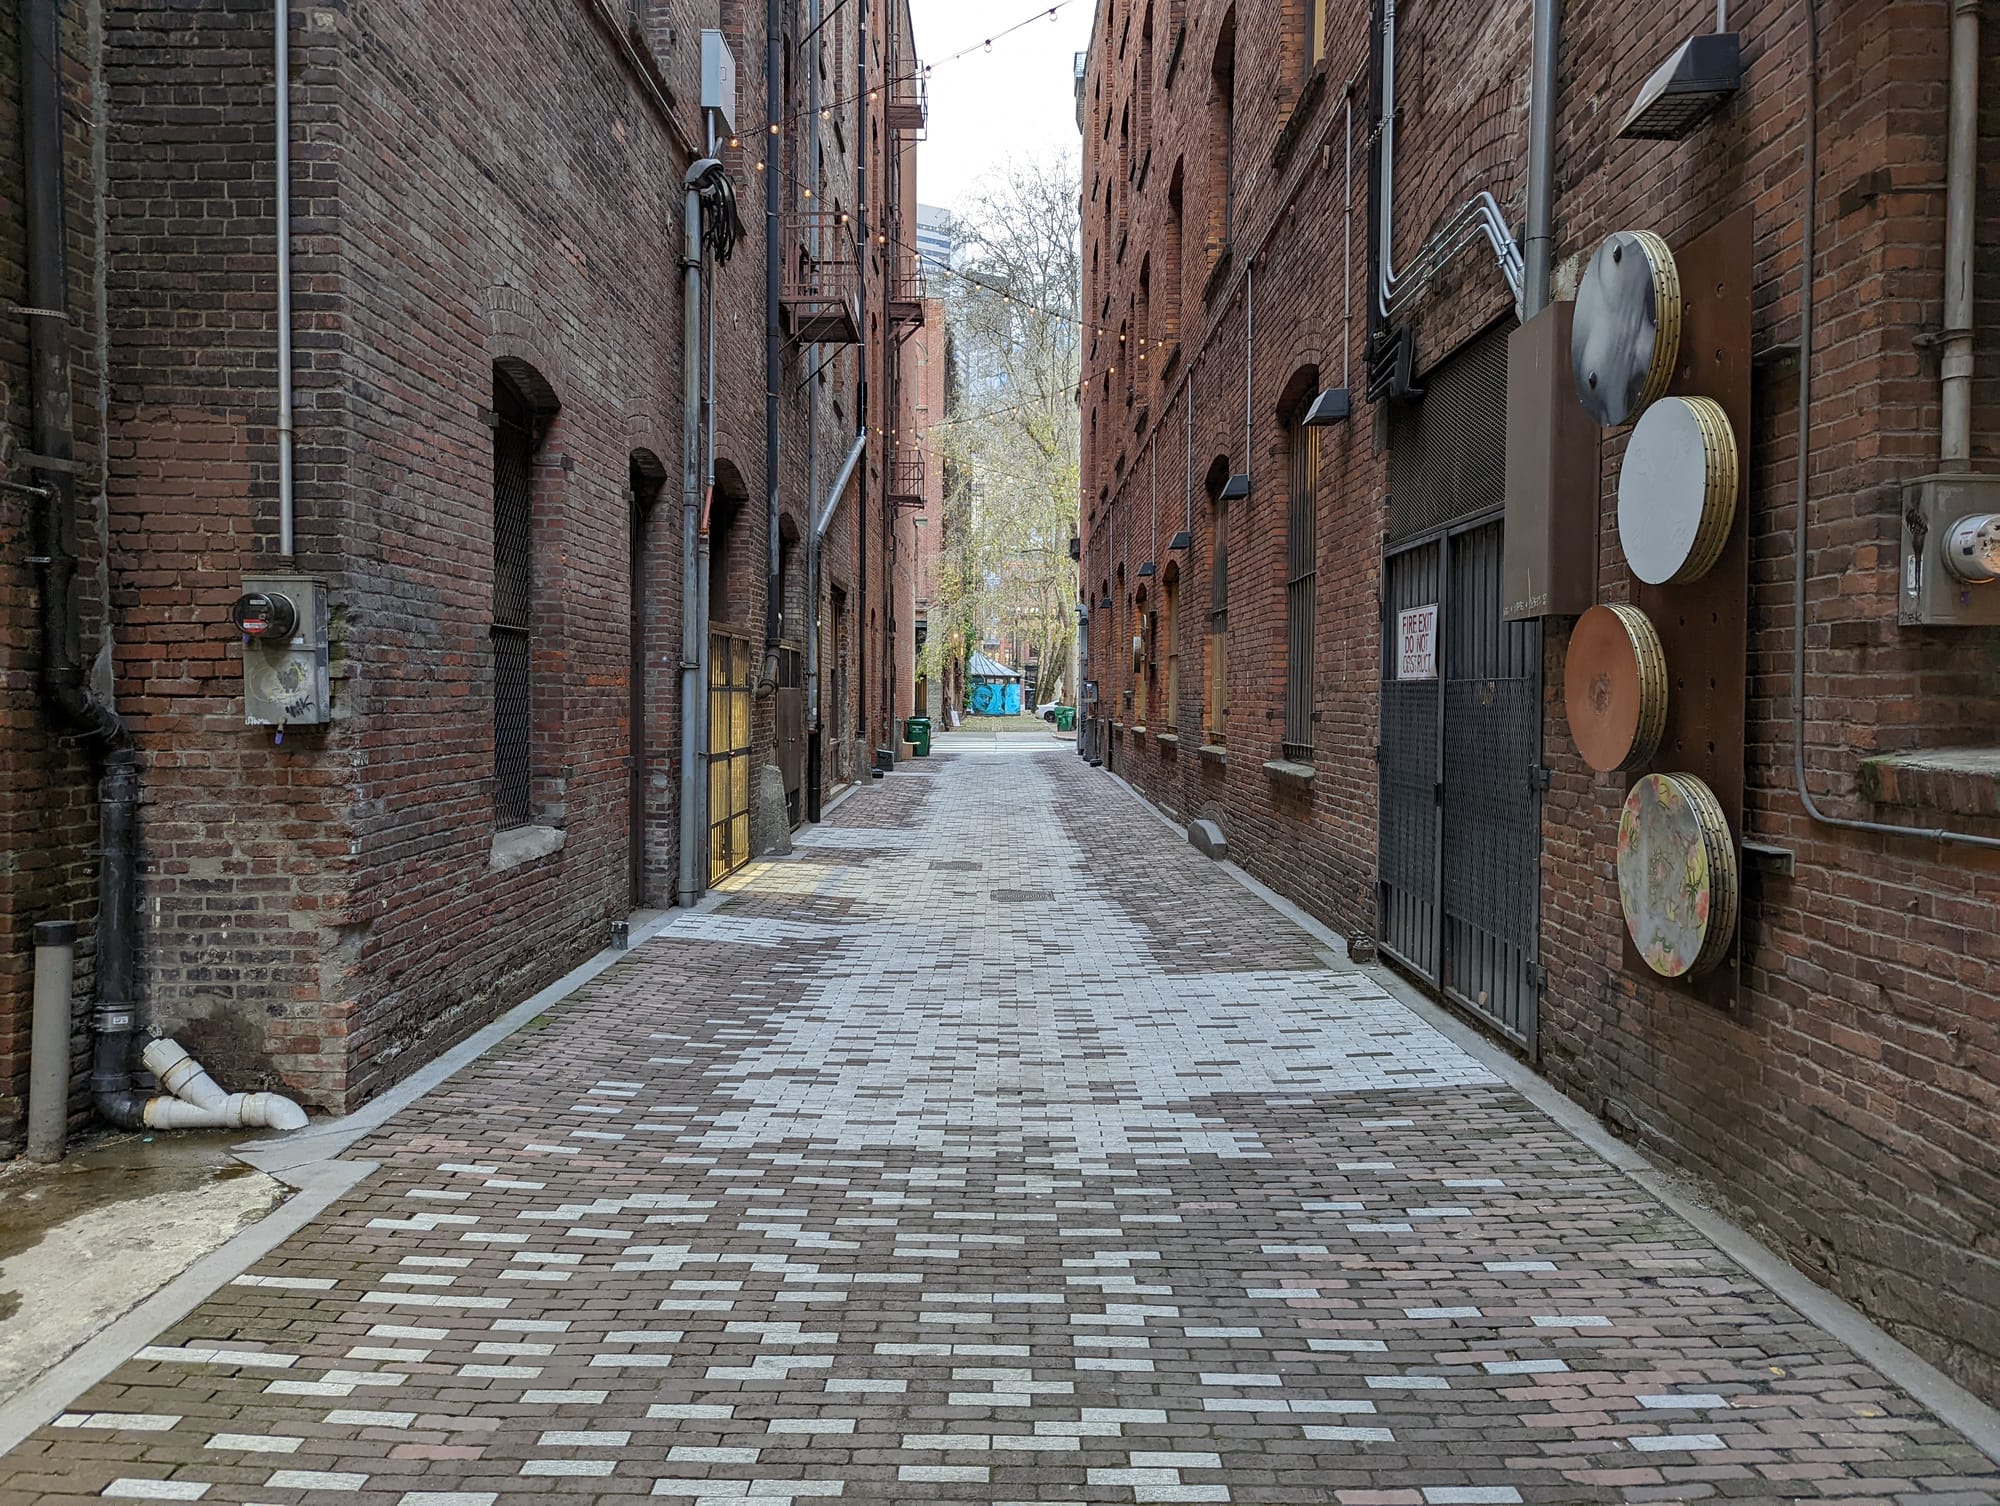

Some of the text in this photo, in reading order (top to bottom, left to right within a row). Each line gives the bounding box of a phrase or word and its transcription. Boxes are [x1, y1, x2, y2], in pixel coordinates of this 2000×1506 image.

[1402, 612, 1433, 635] FIRE EXIT
[1405, 633, 1429, 653] DO NOT
[1403, 653, 1431, 673] OBSTRUCT
